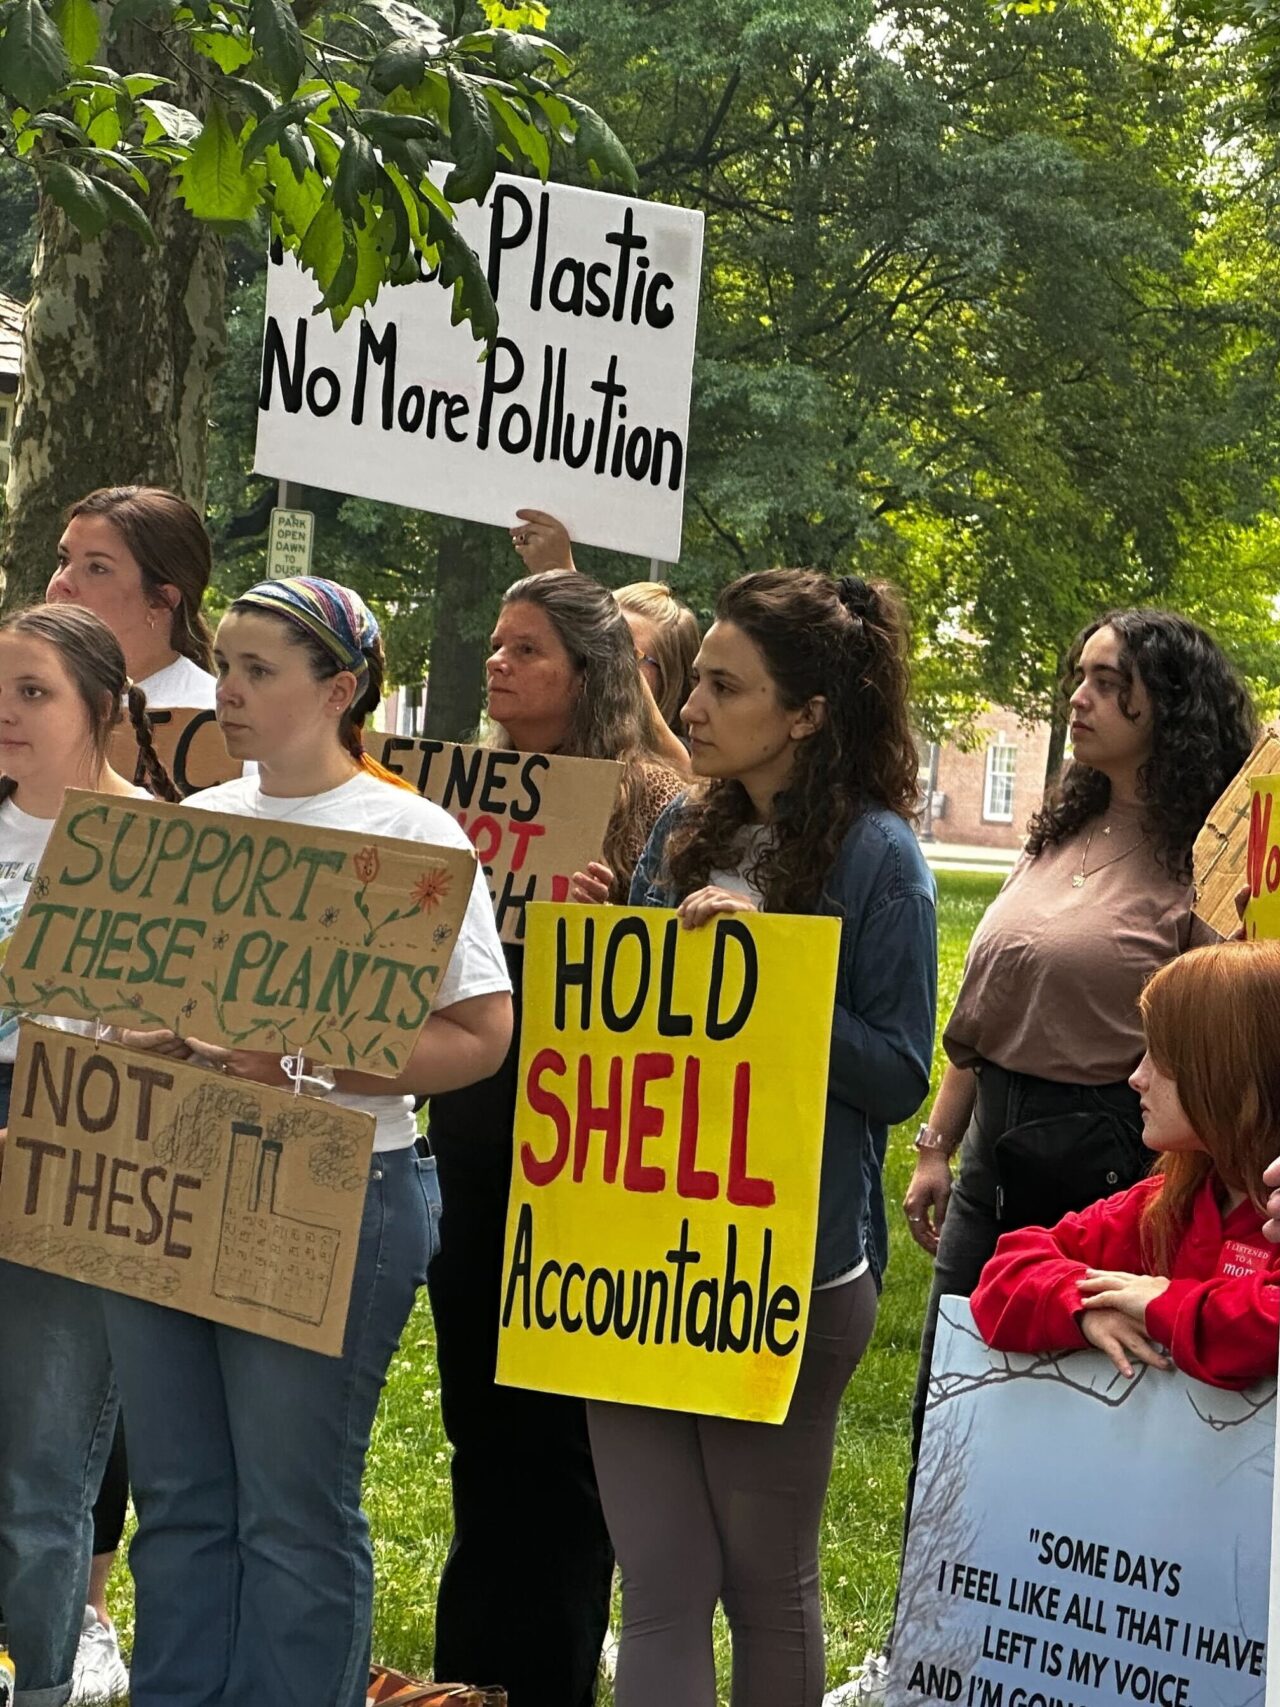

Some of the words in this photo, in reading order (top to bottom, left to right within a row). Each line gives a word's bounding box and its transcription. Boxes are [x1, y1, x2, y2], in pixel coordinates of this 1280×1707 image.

[489, 184, 675, 329] Plastic
[259, 316, 341, 418] No
[351, 319, 469, 443] More
[476, 337, 684, 491] Pollution
[276, 541, 306, 553] DAWN
[277, 529, 306, 541] OPEN
[278, 517, 306, 529] PARK
[285, 554, 296, 564] TO
[275, 564, 302, 576] DUSK
[381, 738, 549, 823] FINES
[60, 806, 347, 923] SUPPORT
[21, 903, 207, 990] THESE
[222, 929, 442, 1031] PLANTS
[554, 915, 759, 1041] HOLD
[21, 1041, 175, 1142] NOT
[520, 1047, 776, 1208] SHELL
[15, 1136, 202, 1260] THESE
[502, 1203, 800, 1357] Accountable
[1235, 1254, 1246, 1263] TO
[1029, 1528, 1110, 1580] "SOME
[1113, 1549, 1182, 1598] DAYS
[937, 1560, 947, 1592] I
[951, 1563, 1002, 1607] FEEL
[1008, 1578, 1061, 1622] LIKE
[1062, 1592, 1107, 1634] ALL
[1115, 1605, 1180, 1654] THAT
[1181, 1622, 1191, 1657] I
[1195, 1627, 1266, 1677] HAVE
[982, 1625, 1038, 1669] LEFT
[1040, 1640, 1064, 1677] IS
[1066, 1648, 1110, 1689] MY
[907, 1661, 963, 1701] AND
